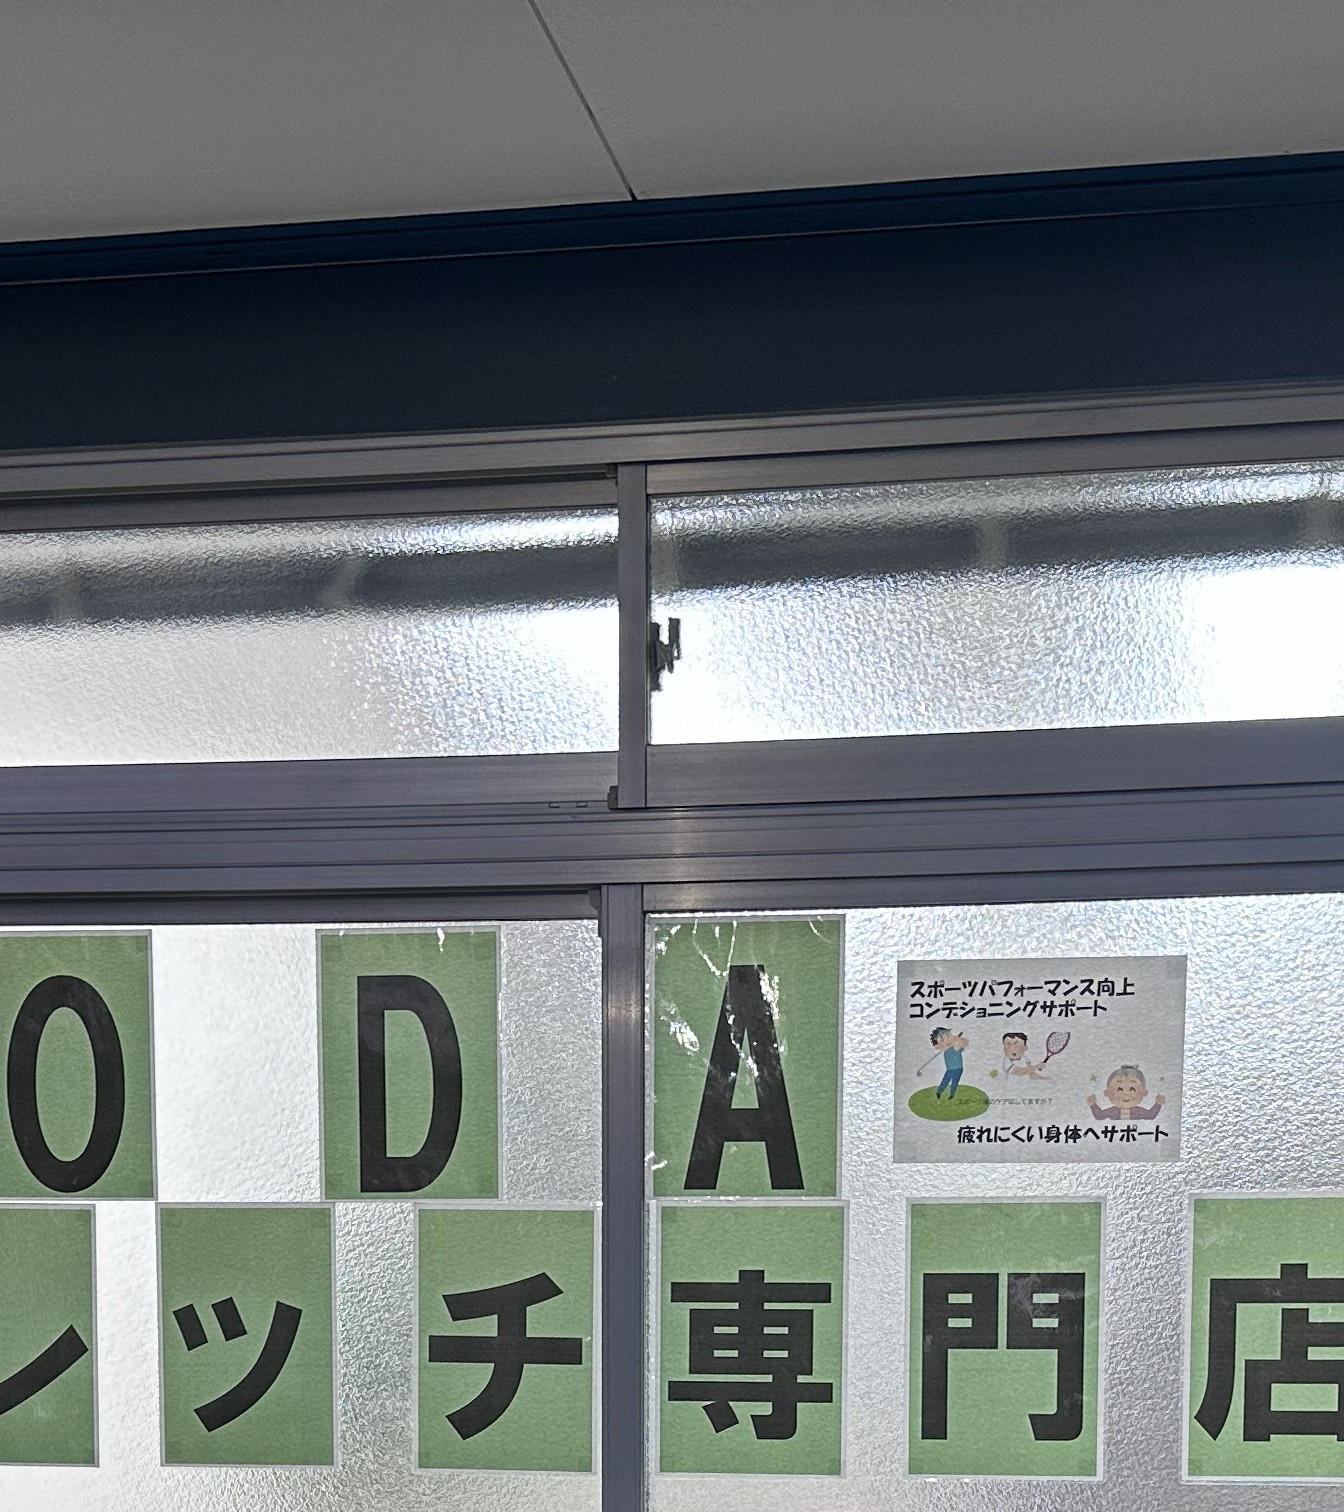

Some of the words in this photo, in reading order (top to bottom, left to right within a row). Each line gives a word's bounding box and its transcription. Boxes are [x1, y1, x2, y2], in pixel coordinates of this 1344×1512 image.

[910, 978, 1135, 998] スポーツパフォーマンス向上
[957, 1124, 1168, 1144] 疲れにくい身体へサポート
